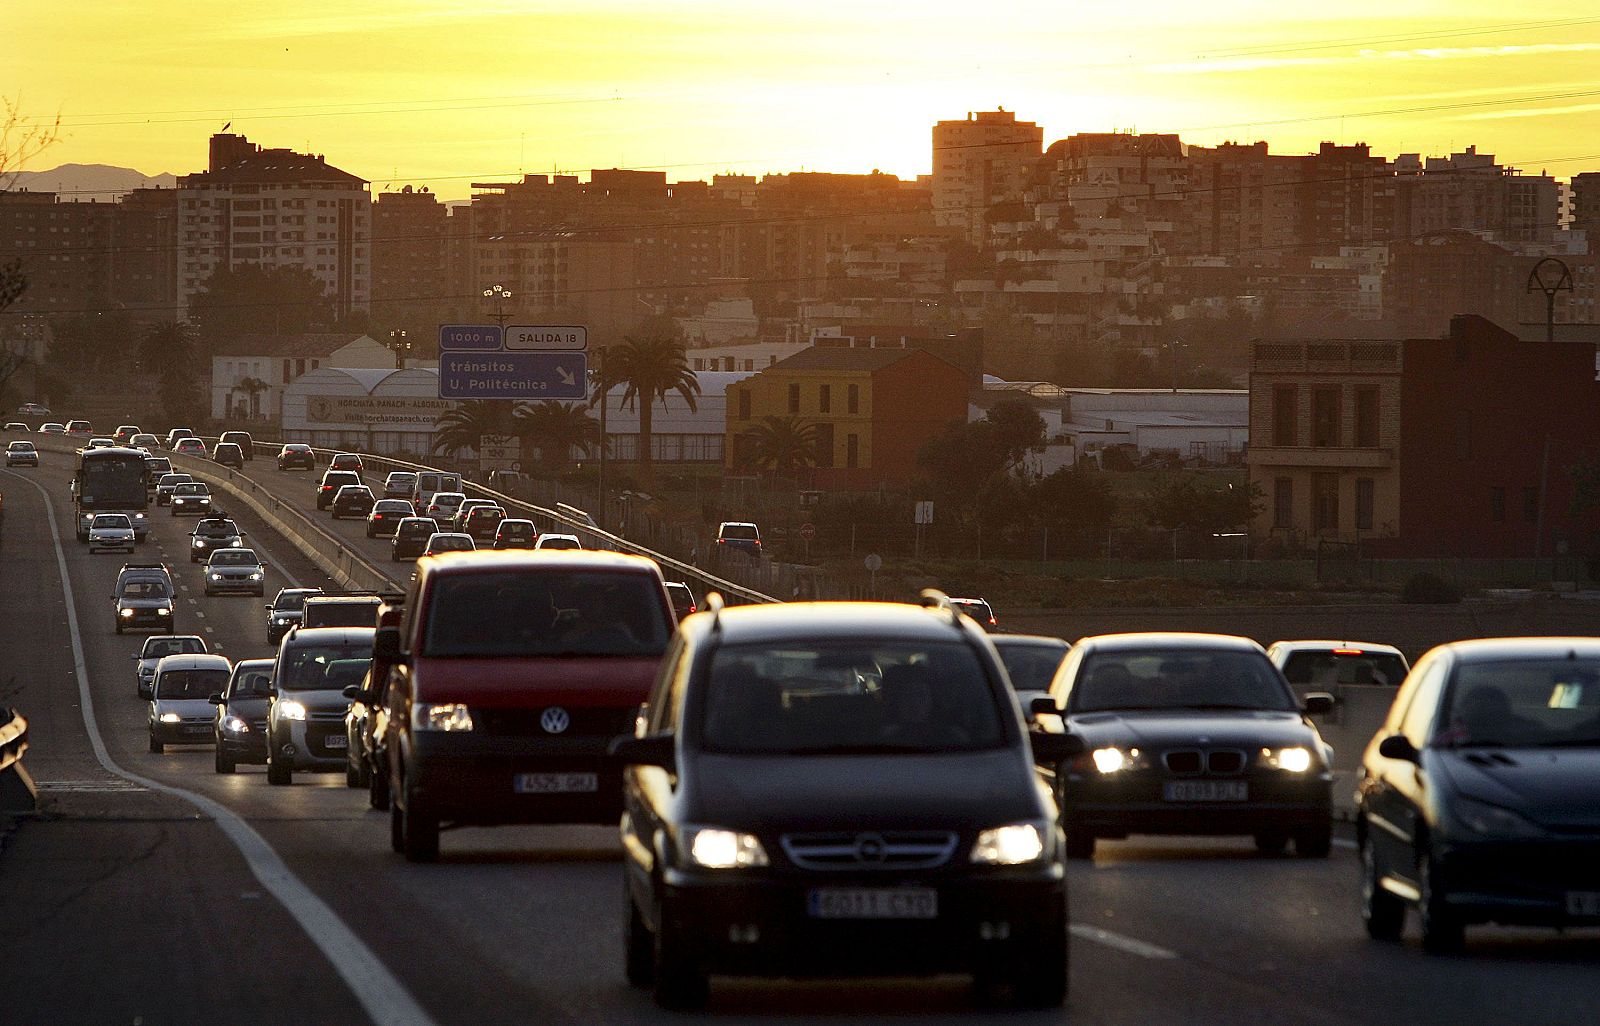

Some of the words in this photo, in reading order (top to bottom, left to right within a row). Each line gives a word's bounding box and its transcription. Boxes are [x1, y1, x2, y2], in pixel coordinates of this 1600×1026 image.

[450, 333, 480, 342] 1000
[519, 333, 562, 343] SALIDA
[566, 334, 577, 343] 18
[450, 361, 514, 372] tránsitos
[450, 380, 463, 390] U.
[469, 379, 547, 390] Politécnica
[337, 400, 374, 408] HORCHATA
[377, 400, 406, 408] PANACH
[412, 400, 449, 409] ALBORAYA
